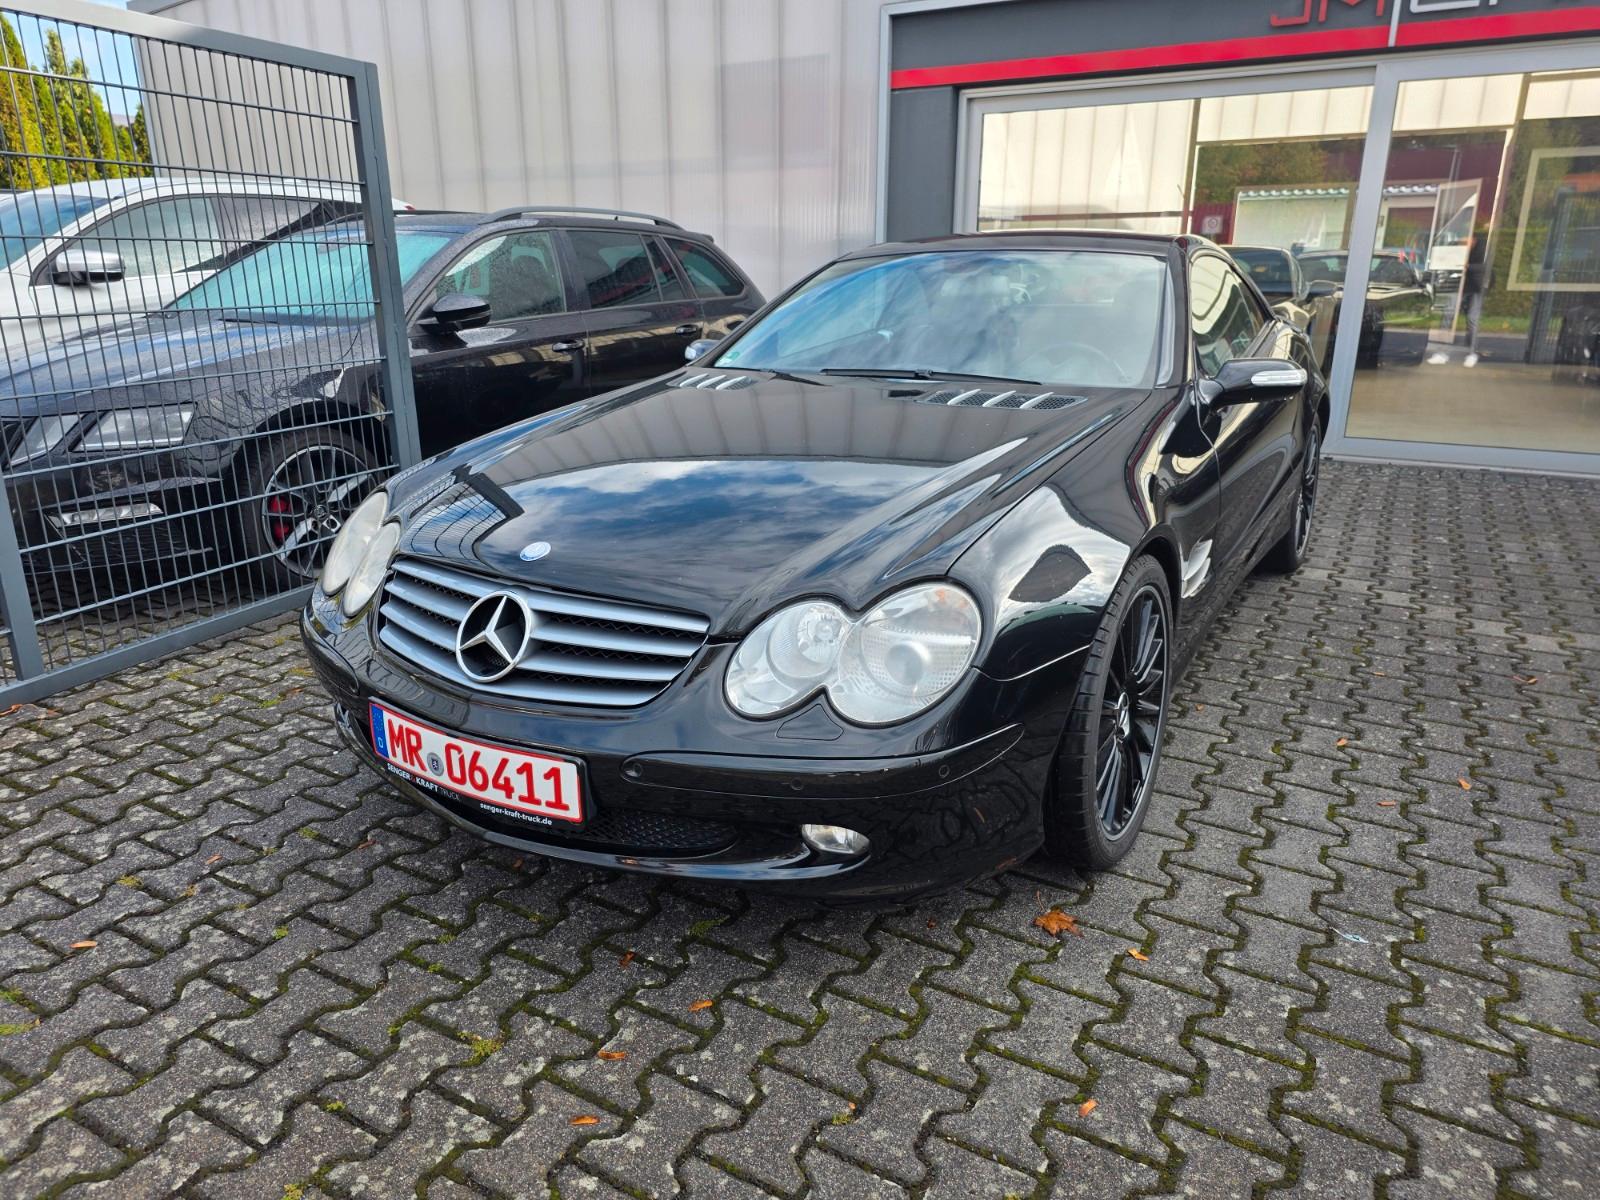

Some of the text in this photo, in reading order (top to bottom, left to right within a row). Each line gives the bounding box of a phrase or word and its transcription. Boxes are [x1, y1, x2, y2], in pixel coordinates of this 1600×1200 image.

[387, 718, 570, 811] MR 06411
[387, 762, 411, 781] SENGER
[415, 776, 439, 793] KRAFT
[479, 803, 553, 826] senger-kraft-truck.de
